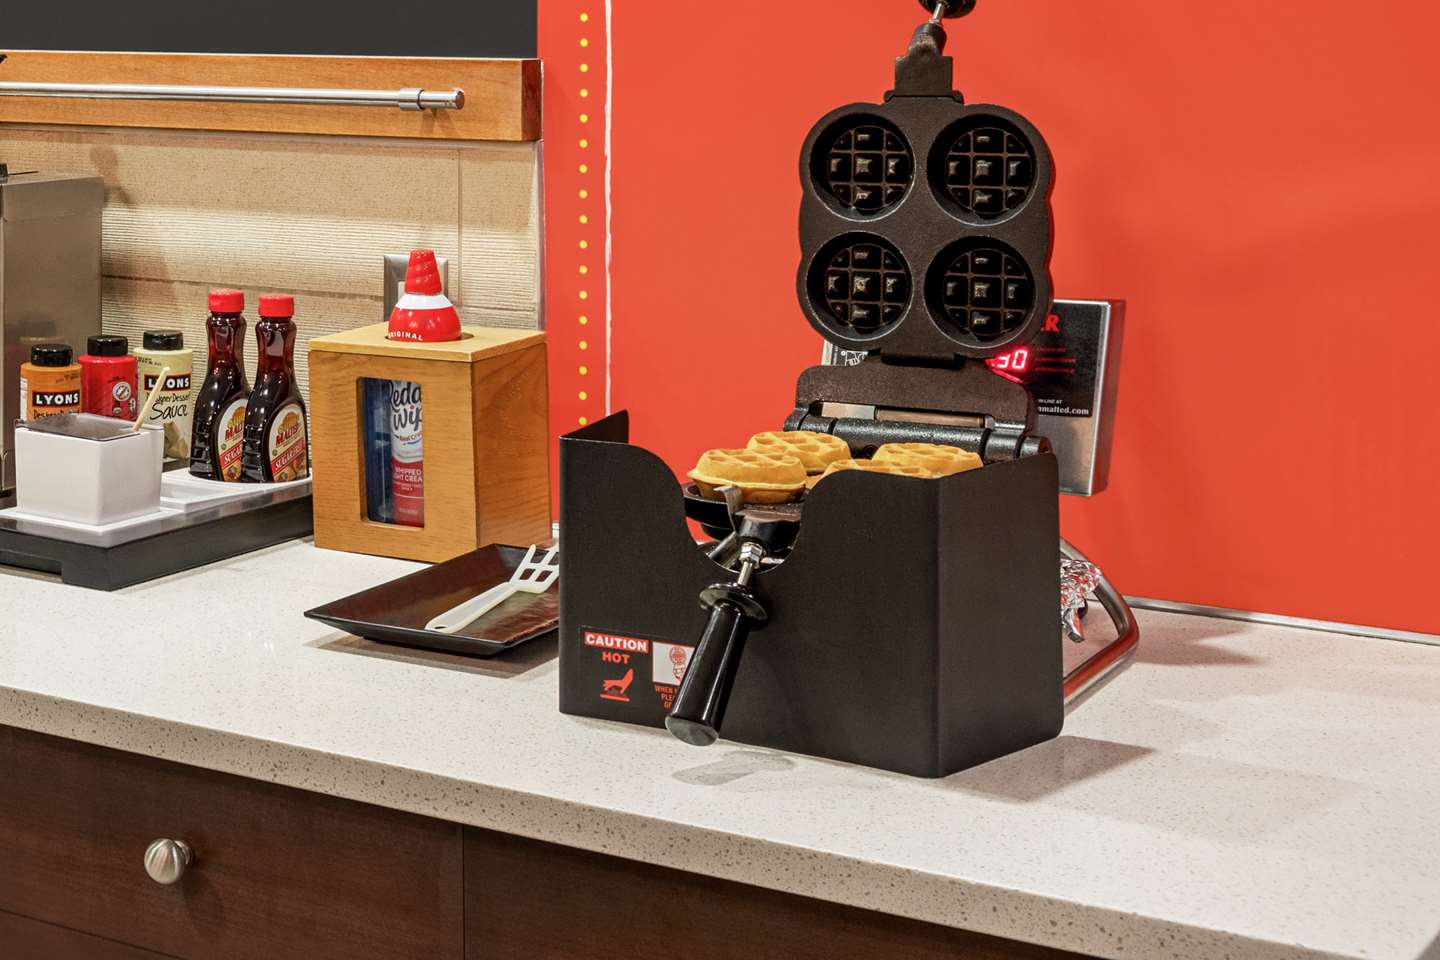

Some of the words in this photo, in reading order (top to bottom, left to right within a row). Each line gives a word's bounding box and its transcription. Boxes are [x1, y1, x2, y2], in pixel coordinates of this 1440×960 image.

[148, 378, 189, 389] LONS
[35, 393, 79, 405] LYONS
[150, 401, 188, 420] Sauce
[585, 633, 647, 651] CAUTION
[602, 651, 630, 664] HOT
